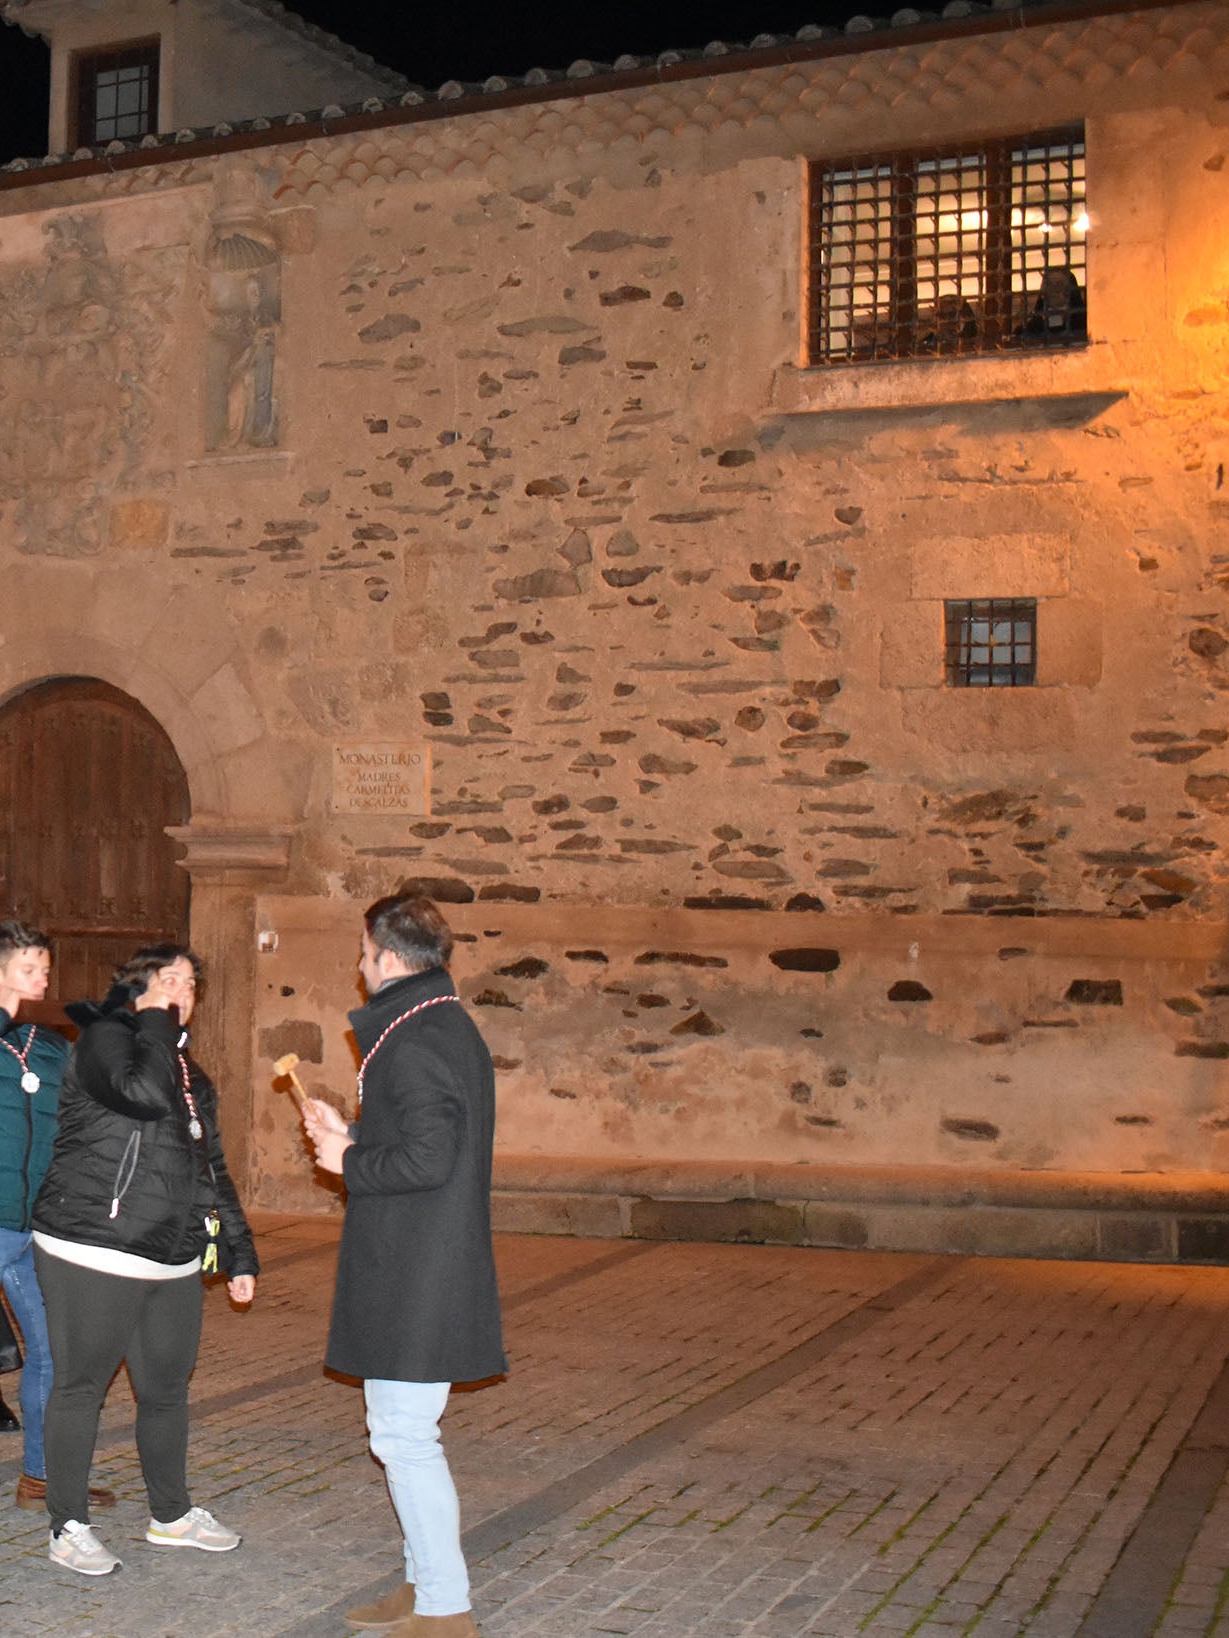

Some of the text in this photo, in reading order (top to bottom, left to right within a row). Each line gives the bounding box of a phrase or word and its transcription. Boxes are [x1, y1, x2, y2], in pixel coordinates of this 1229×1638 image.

[358, 771, 401, 782] MADRES
[346, 784, 411, 795] CARMELITAS
[349, 798, 409, 809] DESCALZAS
